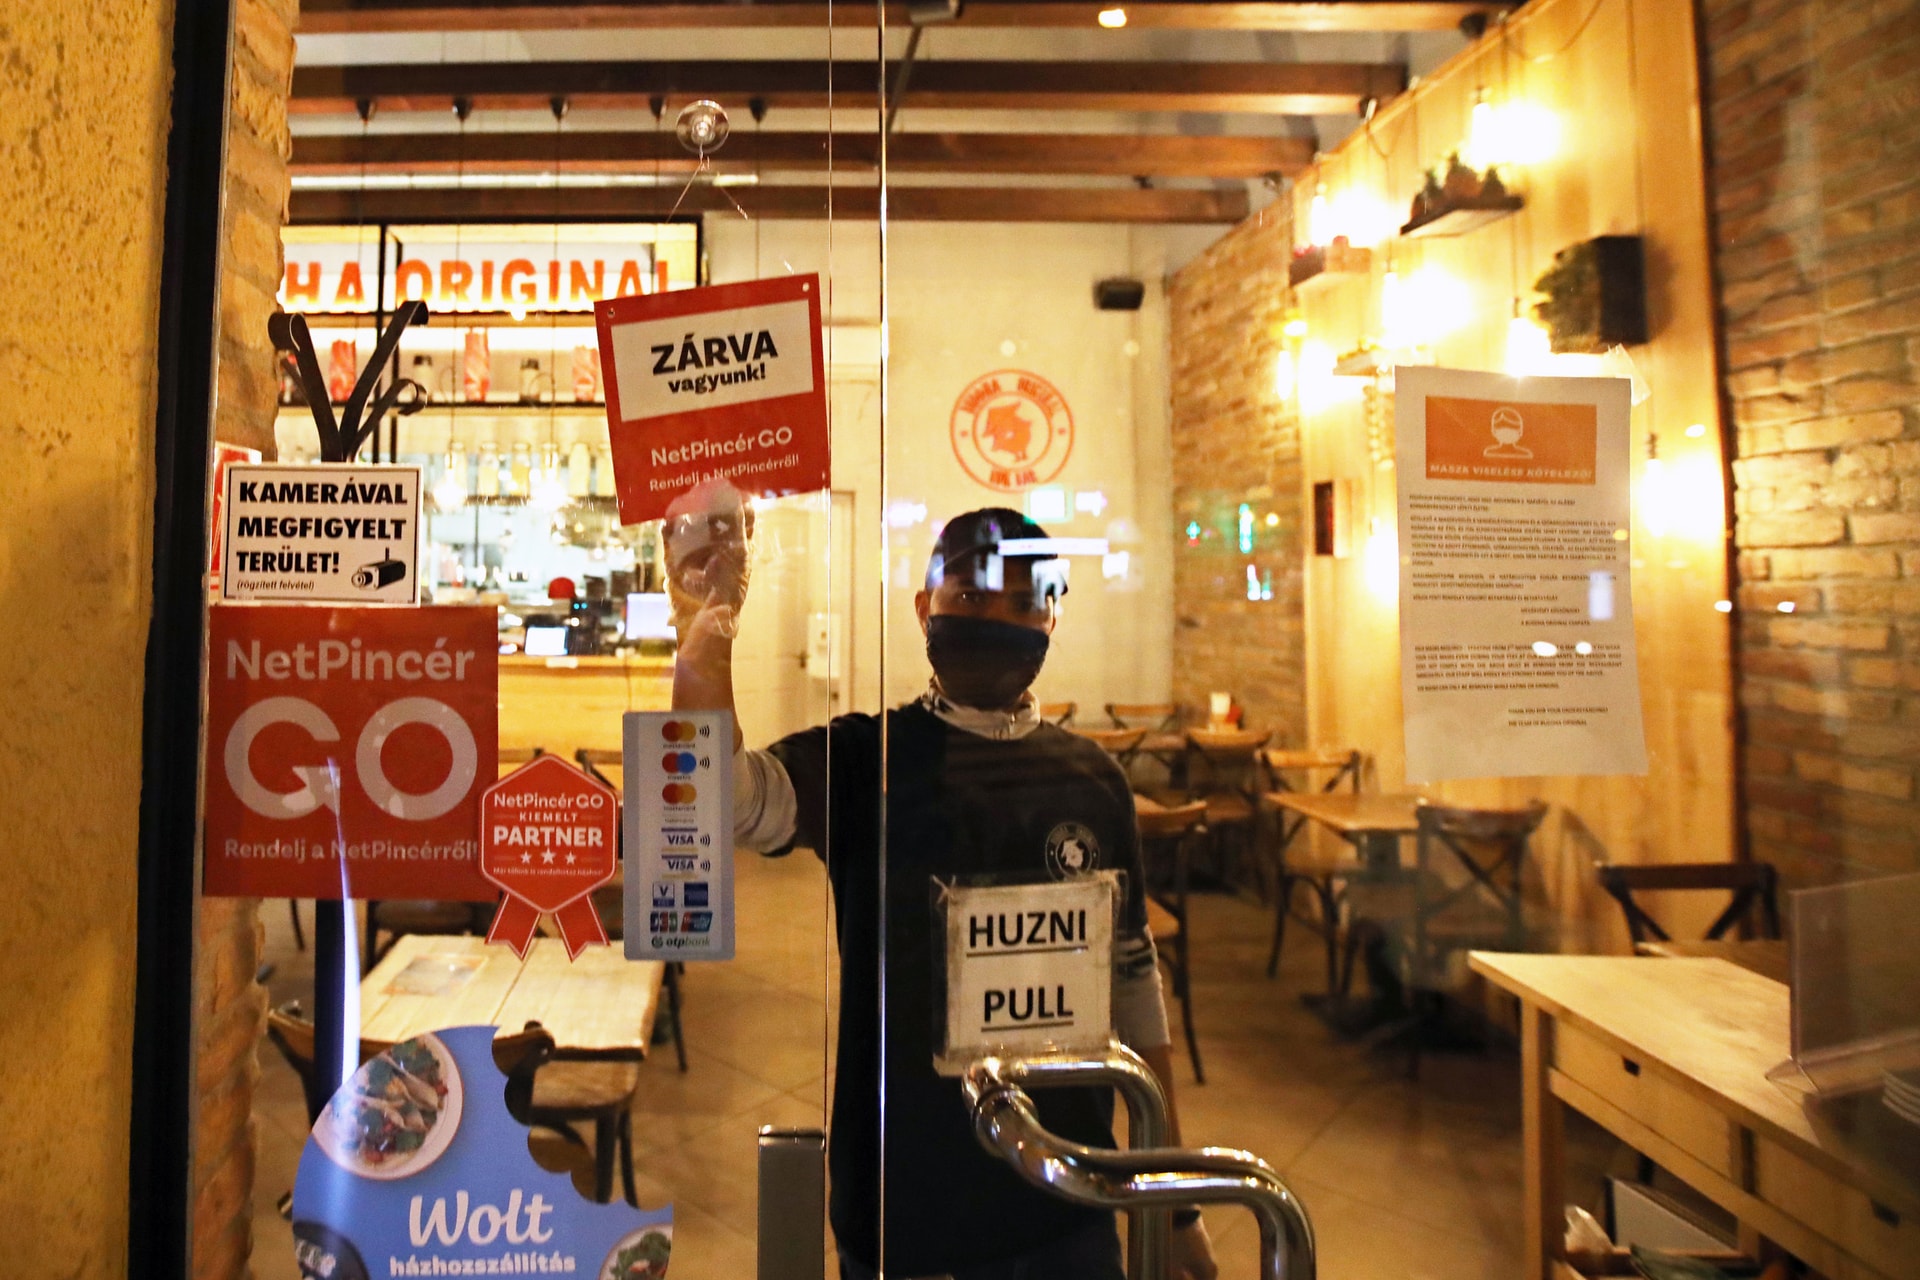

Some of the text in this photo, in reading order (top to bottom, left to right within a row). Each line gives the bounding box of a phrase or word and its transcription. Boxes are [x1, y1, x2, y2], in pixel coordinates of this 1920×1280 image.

[650, 329, 778, 377] ZÁRVA
[668, 362, 766, 395] vagyunk!
[649, 453, 800, 492] Rendelj a NetPincérről!
[1430, 464, 1469, 475] MASZK
[1473, 465, 1524, 477] VISELÉSE
[239, 477, 408, 505] KAMERÁVAL
[237, 516, 407, 540] MEGFIGYELT
[236, 545, 340, 574] TERÜLET!
[236, 579, 315, 592] (rögzített felvétel)
[226, 636, 476, 682] NetPincér
[224, 695, 479, 822] GO
[519, 811, 579, 823] KIEMELT
[493, 825, 604, 848] PARTNER
[668, 834, 695, 846] VISA
[224, 838, 306, 864] Rendelj
[311, 843, 325, 860] a
[668, 860, 695, 871] VISA
[968, 908, 1087, 949] HUZNI
[983, 984, 1074, 1024] PULL
[408, 1187, 554, 1248] Wolt
[388, 1250, 576, 1278] házhozszállítás
